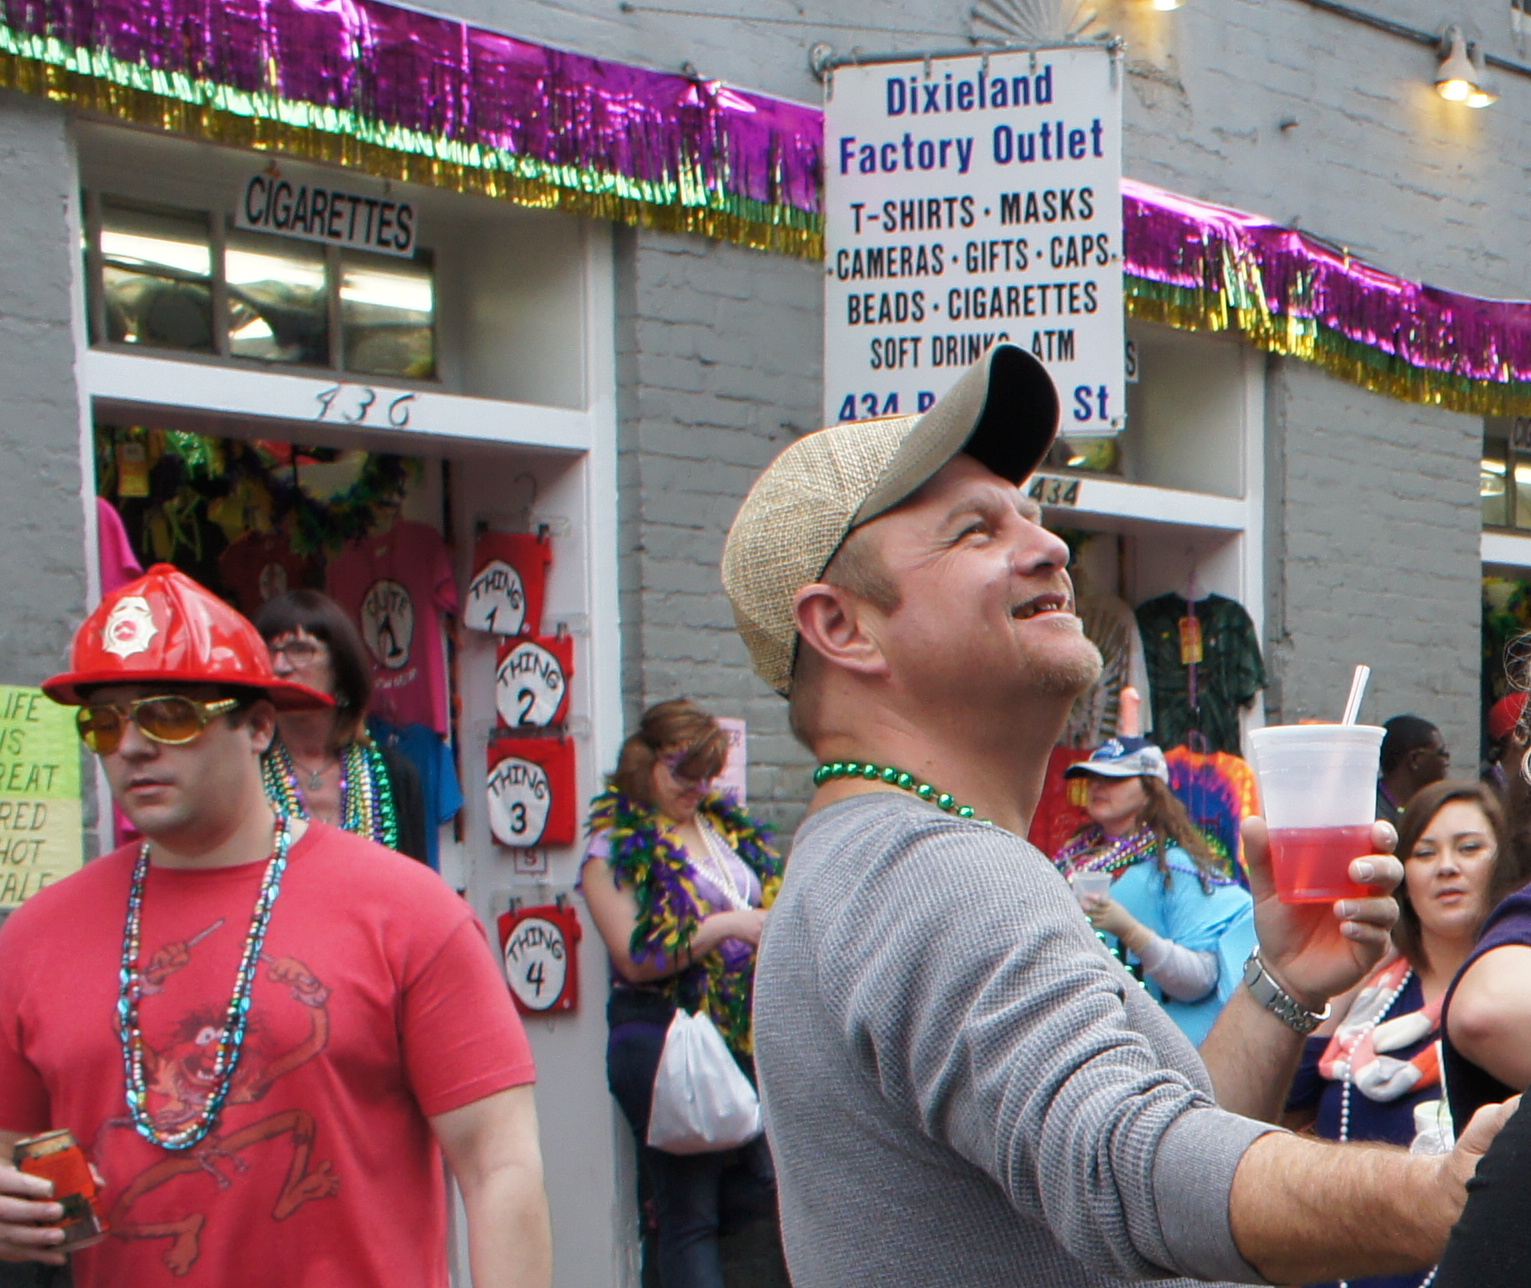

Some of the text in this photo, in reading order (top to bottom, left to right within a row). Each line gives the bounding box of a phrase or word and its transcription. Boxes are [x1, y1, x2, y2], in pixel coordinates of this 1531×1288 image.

[887, 64, 1053, 116] Dixieland
[839, 118, 1104, 175] Factory Outlet
[245, 175, 413, 250] CIGARETTES
[850, 187, 1094, 234] T-SHIRTS MASKS
[837, 233, 1109, 281] CAMERAS GIFTS CAPS
[848, 280, 1098, 326] BEADS CIGARETTES
[870, 328, 1075, 370] SOFT DRINK ATM
[315, 383, 416, 428] 436
[1073, 384, 1109, 421] St
[1028, 476, 1078, 505] 434
[470, 569, 522, 610] THING
[485, 605, 498, 633] 1
[496, 651, 561, 690] THING
[0, 692, 42, 722] IFE
[517, 688, 536, 725] 2
[487, 764, 548, 800] THING
[510, 801, 527, 834] 3
[507, 926, 564, 962] THING
[525, 960, 545, 998] 4
